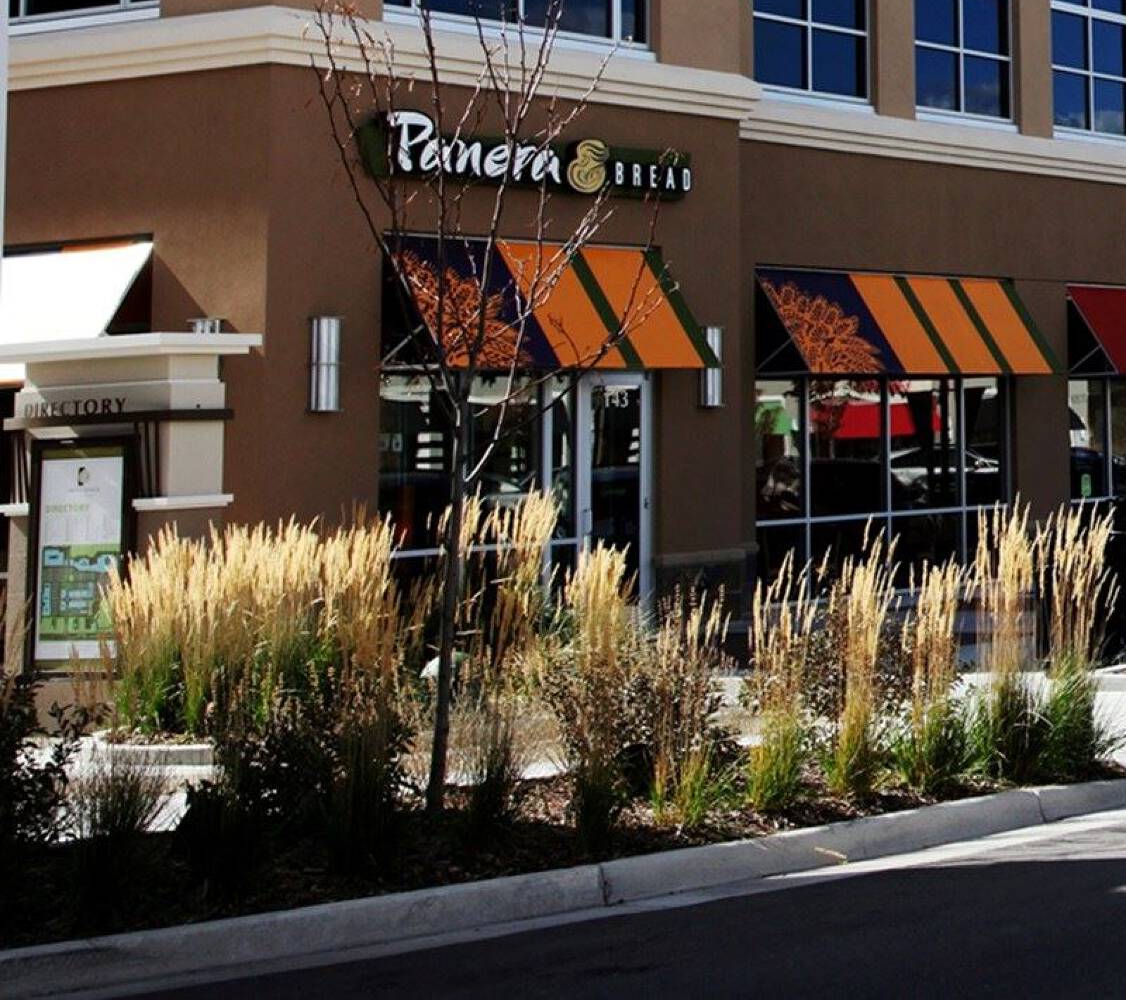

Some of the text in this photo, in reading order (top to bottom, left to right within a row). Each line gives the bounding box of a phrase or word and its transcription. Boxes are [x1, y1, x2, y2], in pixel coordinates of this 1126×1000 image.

[387, 110, 693, 192] Panera BREAD
[24, 397, 127, 418] DIRECTORY
